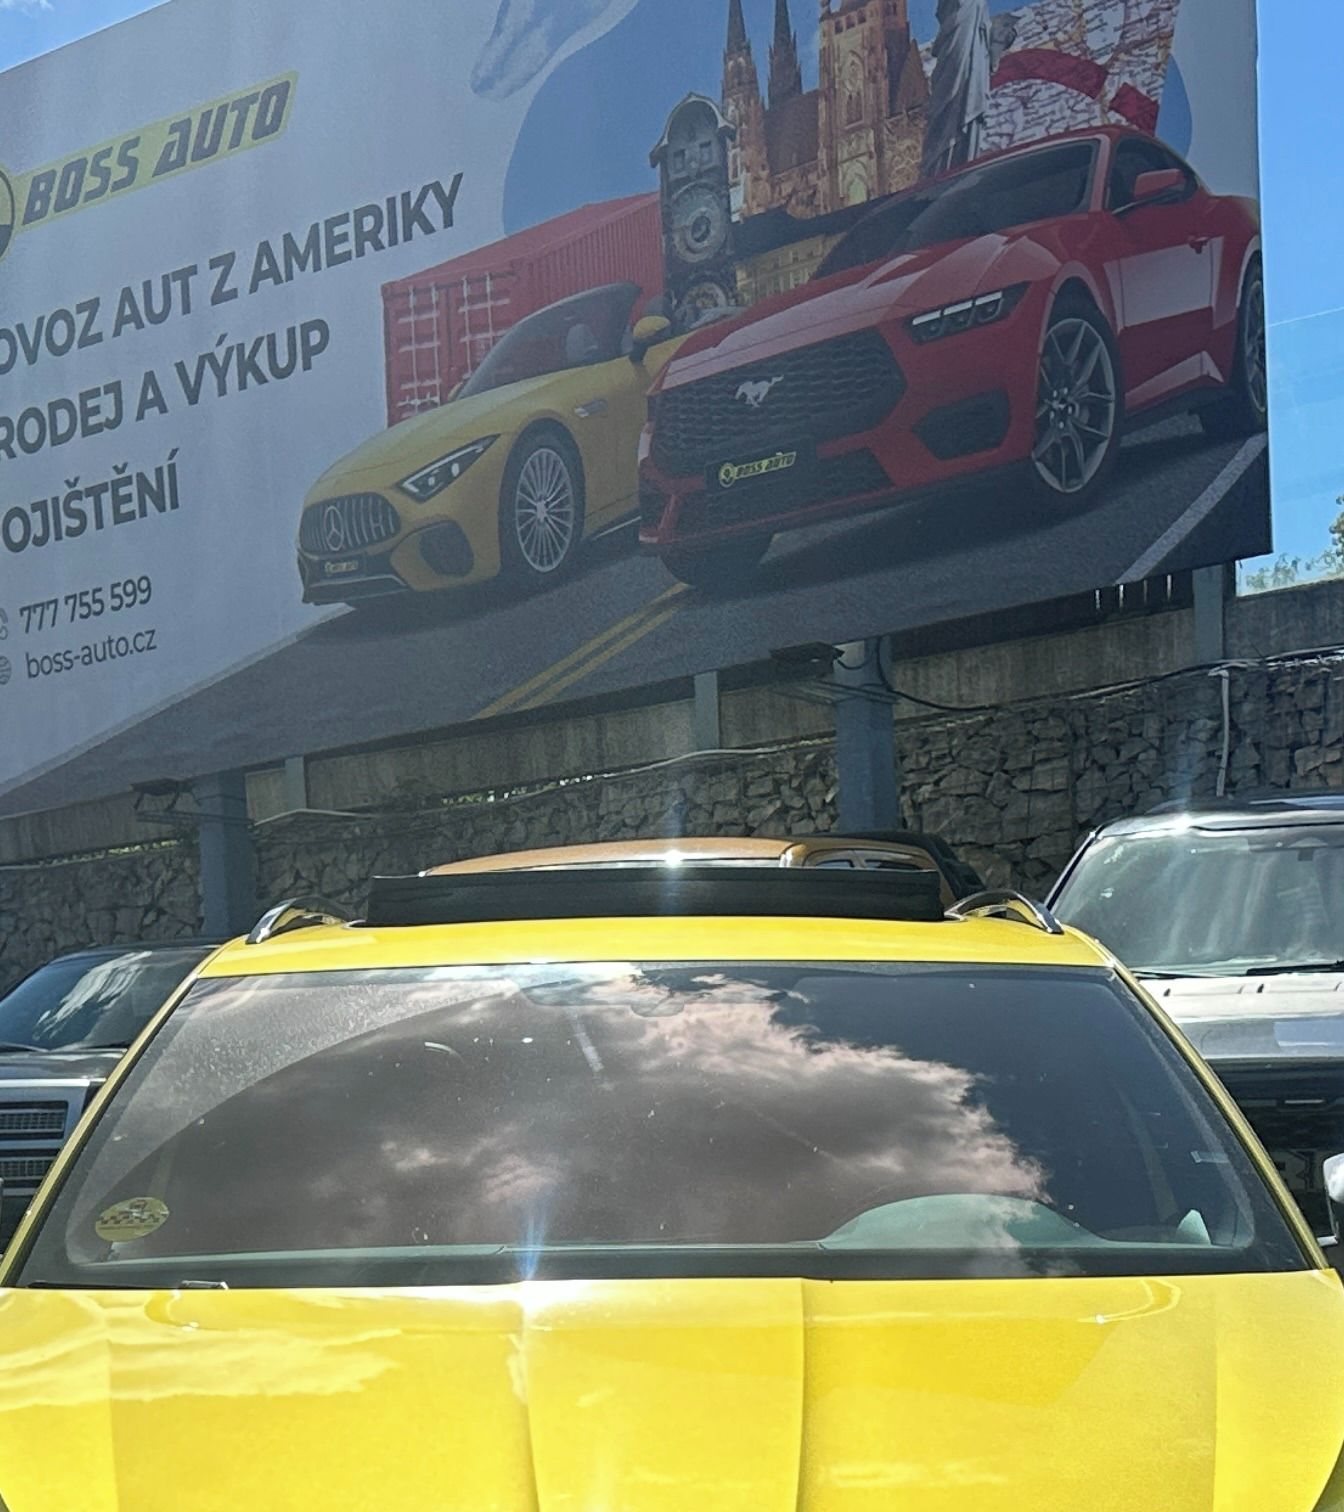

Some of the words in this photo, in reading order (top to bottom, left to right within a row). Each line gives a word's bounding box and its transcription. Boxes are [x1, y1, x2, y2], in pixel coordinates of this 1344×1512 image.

[21, 136, 142, 226] BOSS
[152, 79, 292, 178] AUTO
[112, 265, 198, 338] AUT
[208, 251, 238, 306] Z
[248, 172, 464, 295] AMERIKY
[135, 370, 168, 423] A
[174, 318, 330, 405] VÝKUP
[19, 598, 59, 634] 777
[64, 587, 105, 623] 755
[110, 575, 152, 612] 599
[25, 629, 157, 679] boss-auto.cz
